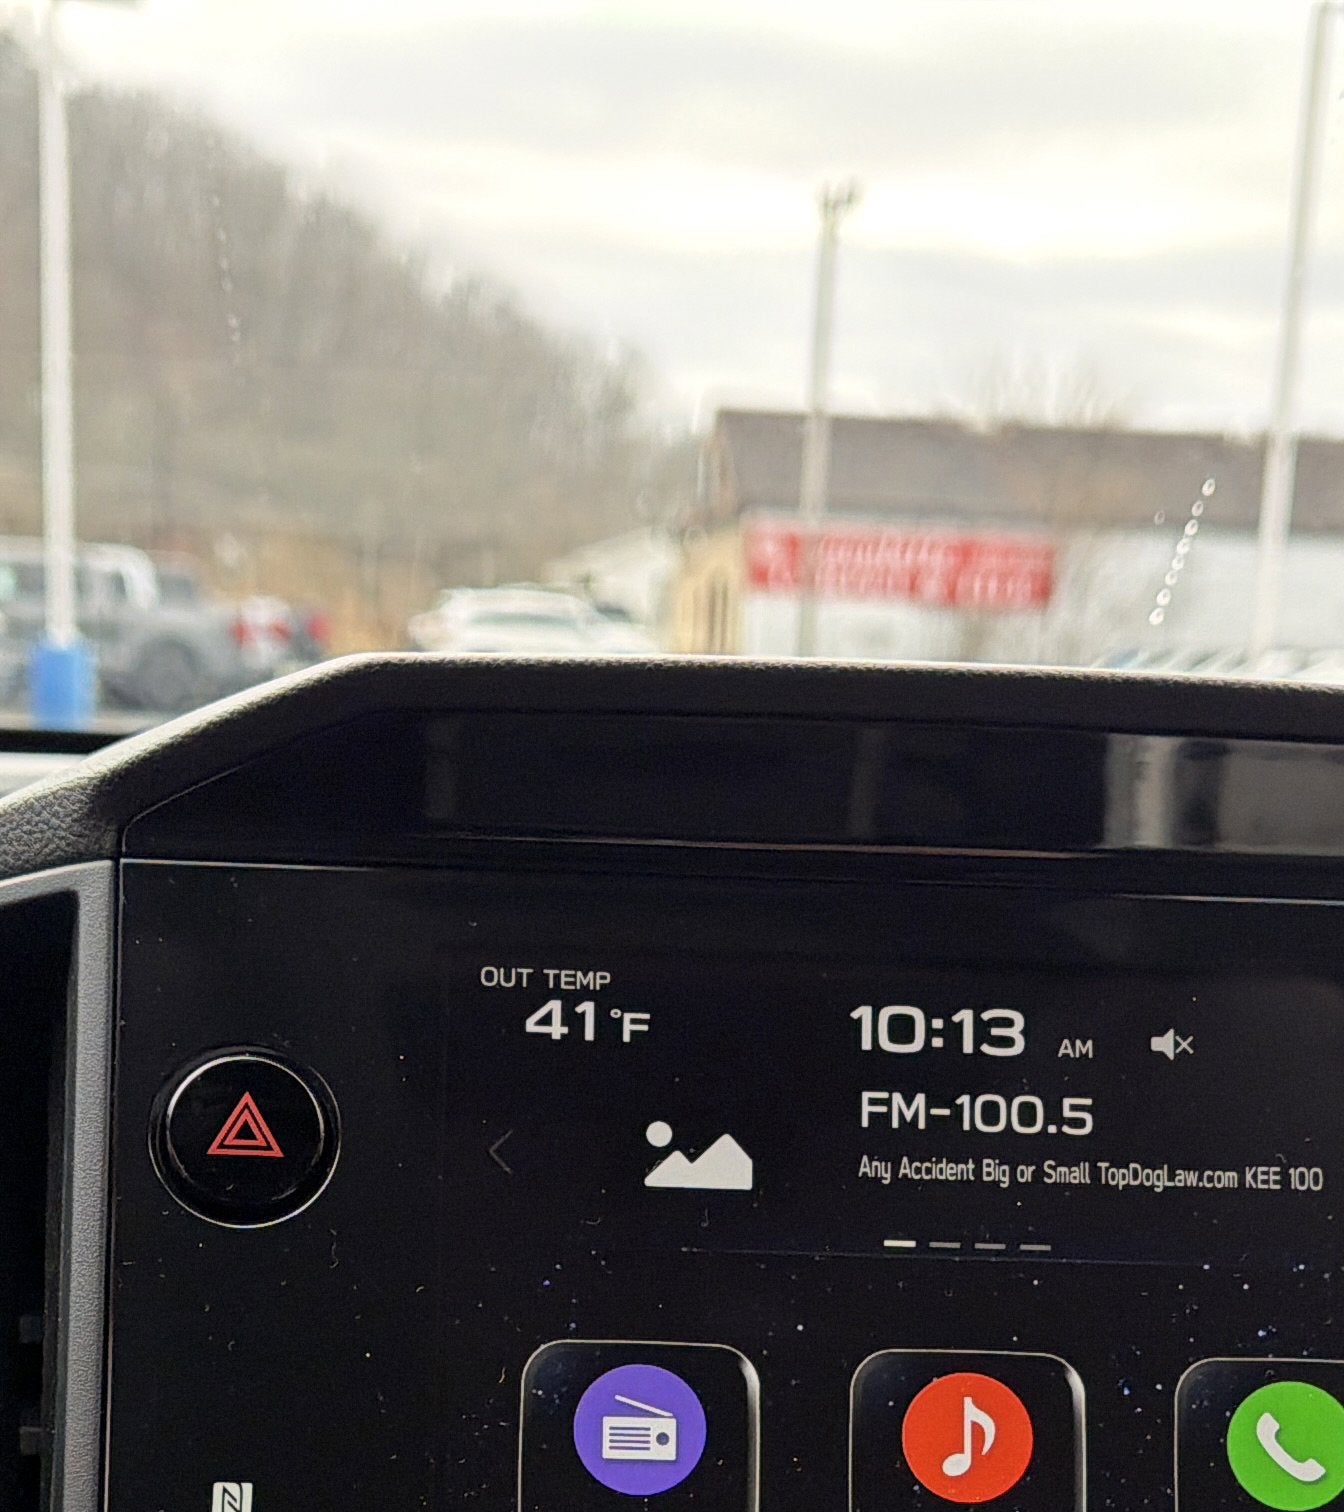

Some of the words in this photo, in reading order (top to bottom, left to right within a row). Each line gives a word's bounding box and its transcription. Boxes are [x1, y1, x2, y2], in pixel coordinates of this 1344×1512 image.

[480, 965, 534, 988] OUT
[543, 969, 611, 990] TEMP
[850, 1005, 1026, 1057] 10:13
[1057, 1038, 1093, 1059] AM
[861, 1091, 1094, 1136] FM-100.5
[858, 1154, 892, 1185] Any
[898, 1156, 975, 1181] Accident
[982, 1158, 1010, 1188] Big
[1016, 1164, 1036, 1183] or
[1043, 1160, 1091, 1184] Small
[1097, 1161, 1239, 1193] TopDogLaw.com
[1245, 1166, 1281, 1190] KEE
[1288, 1166, 1324, 1191] 100
